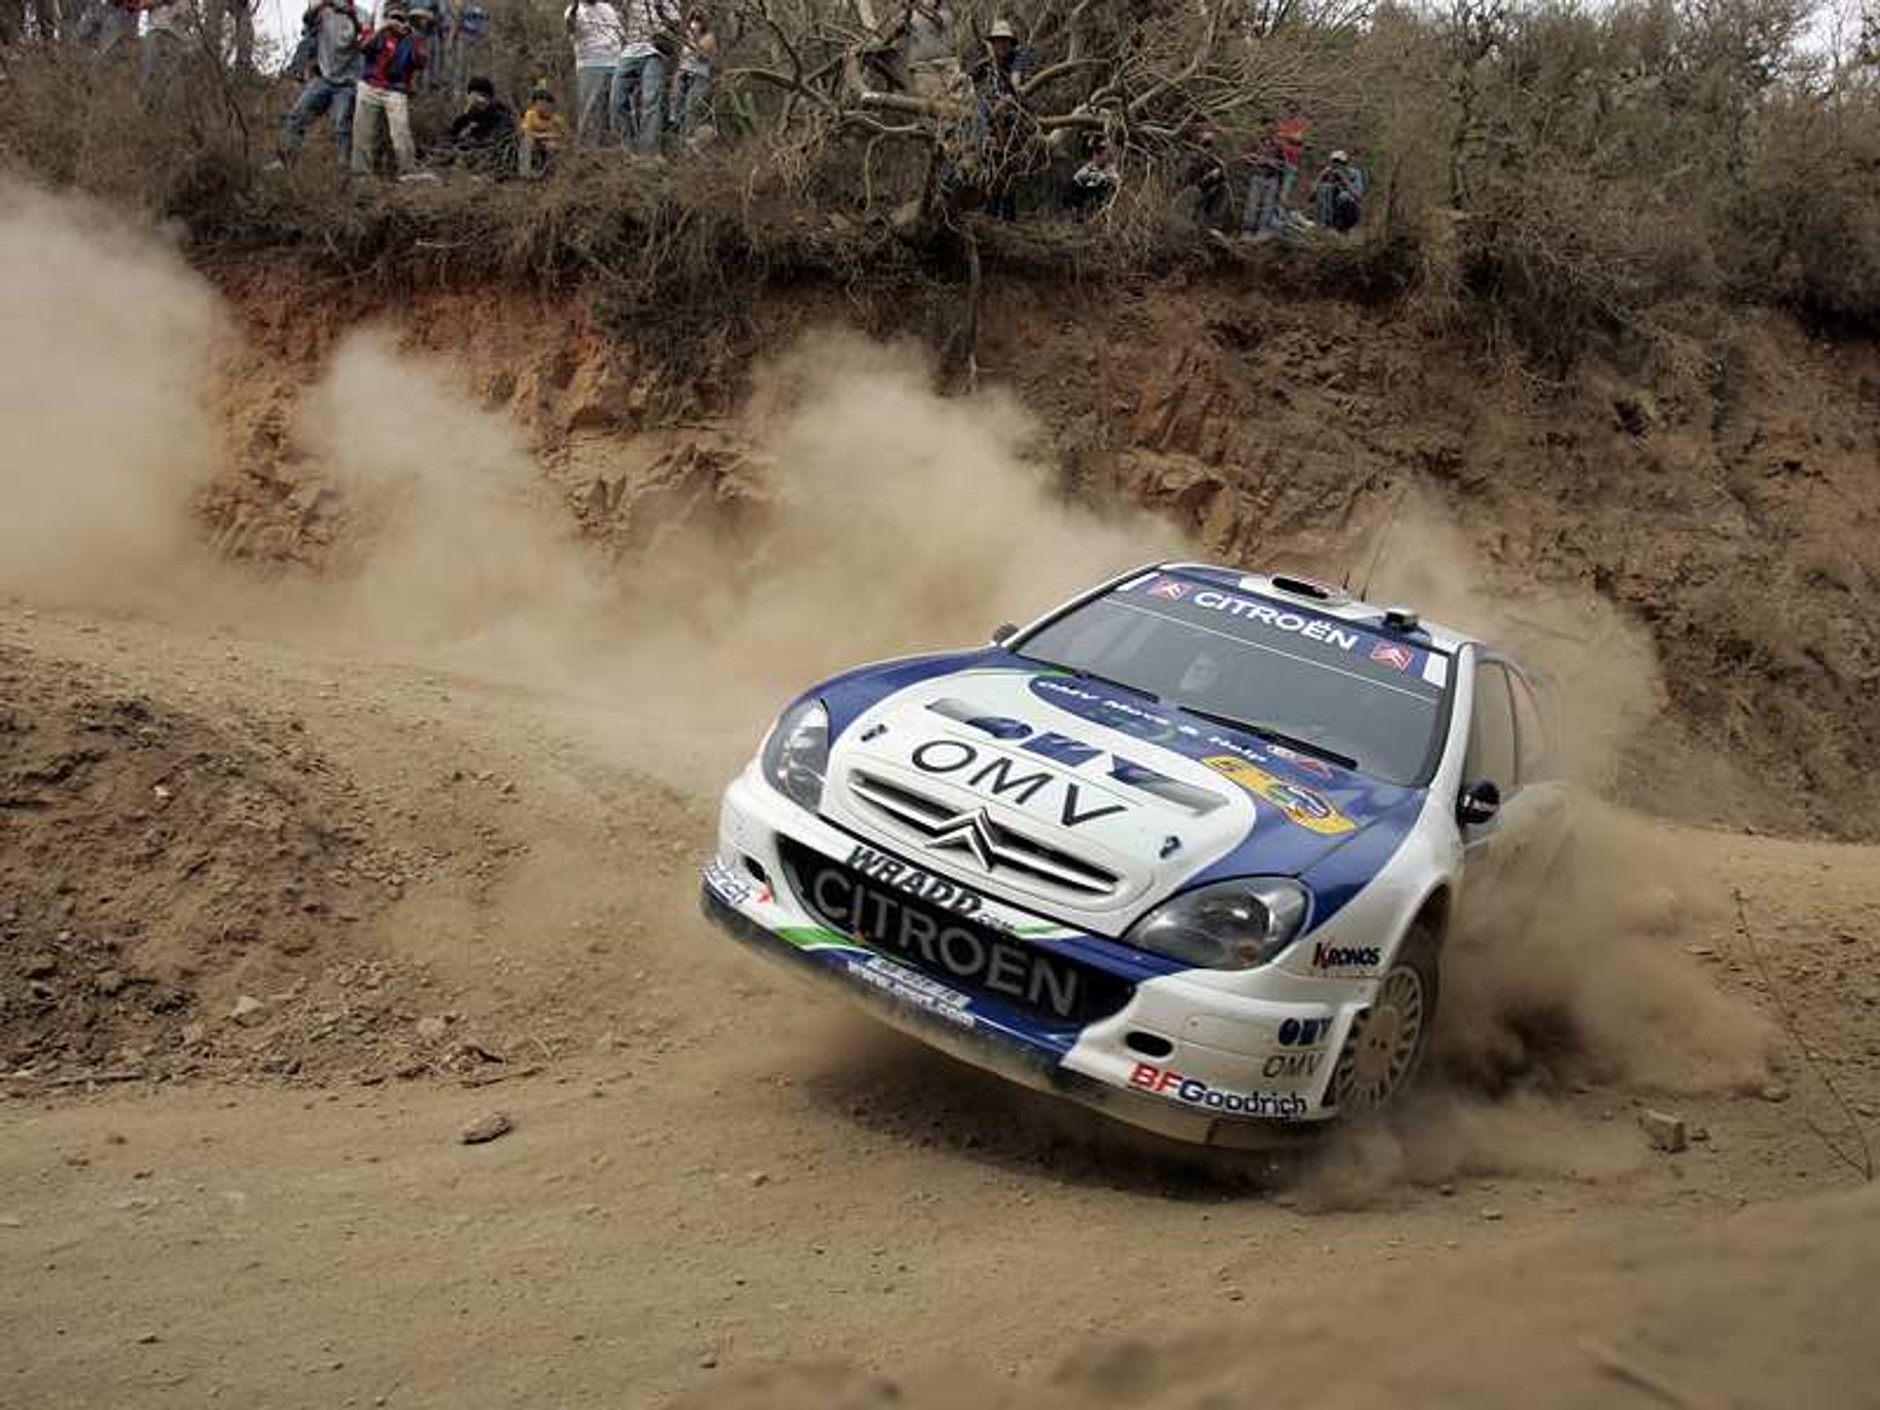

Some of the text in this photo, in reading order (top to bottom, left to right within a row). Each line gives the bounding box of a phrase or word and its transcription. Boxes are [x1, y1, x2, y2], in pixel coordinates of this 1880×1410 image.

[1193, 592, 1359, 649] CITROËN
[911, 740, 1129, 827] OMV
[1130, 1062, 1308, 1115] BFGoodrich
[1262, 1052, 1325, 1078] OMV
